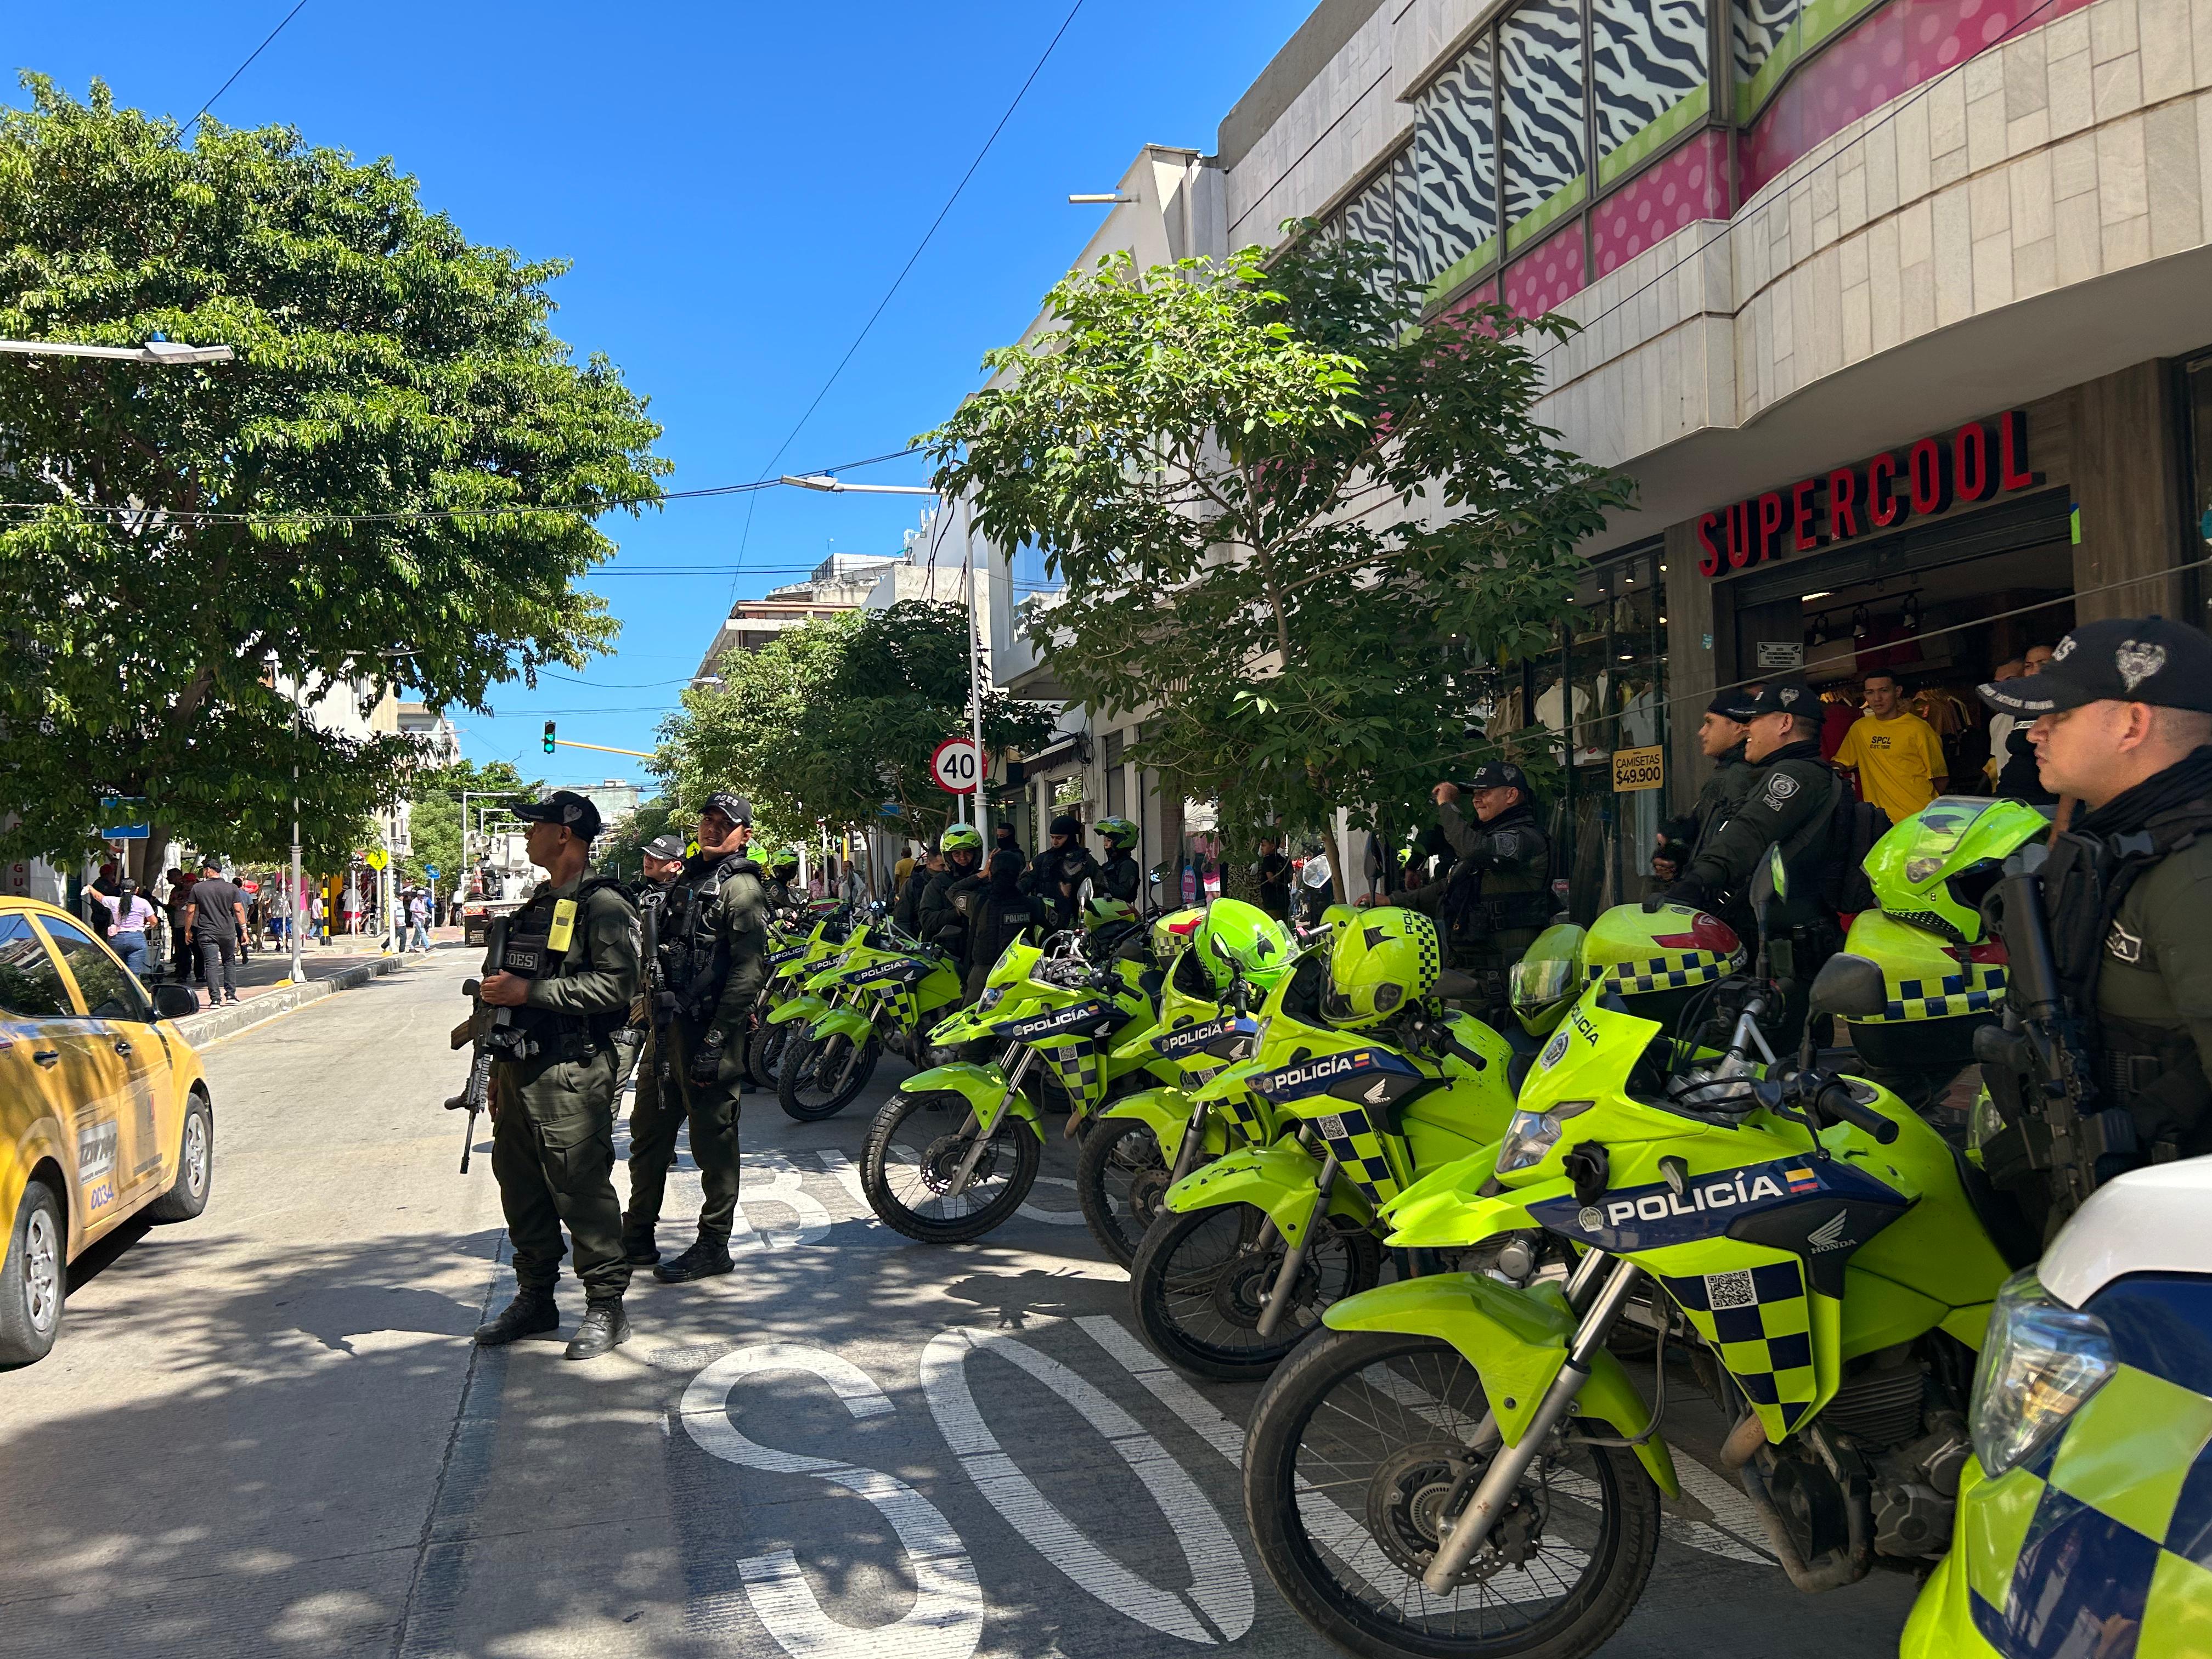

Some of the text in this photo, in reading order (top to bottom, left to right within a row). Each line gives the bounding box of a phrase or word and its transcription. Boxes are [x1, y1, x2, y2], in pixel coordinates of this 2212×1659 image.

[1697, 410, 2033, 577] SUPERCOOL
[1871, 736, 1891, 744] SPCL
[943, 753, 975, 779] 40
[1616, 754, 1660, 769] CAMISETAS
[1616, 766, 1661, 786] $49.900
[1005, 913, 1030, 923] POLICIA
[817, 957, 840, 969] POLIC
[1023, 1008, 1090, 1035] POLICÍA
[1274, 1055, 1352, 1089] POLICÍA
[1607, 1170, 1784, 1226] POLICÍA
[1811, 1238, 1857, 1254] HONDA
